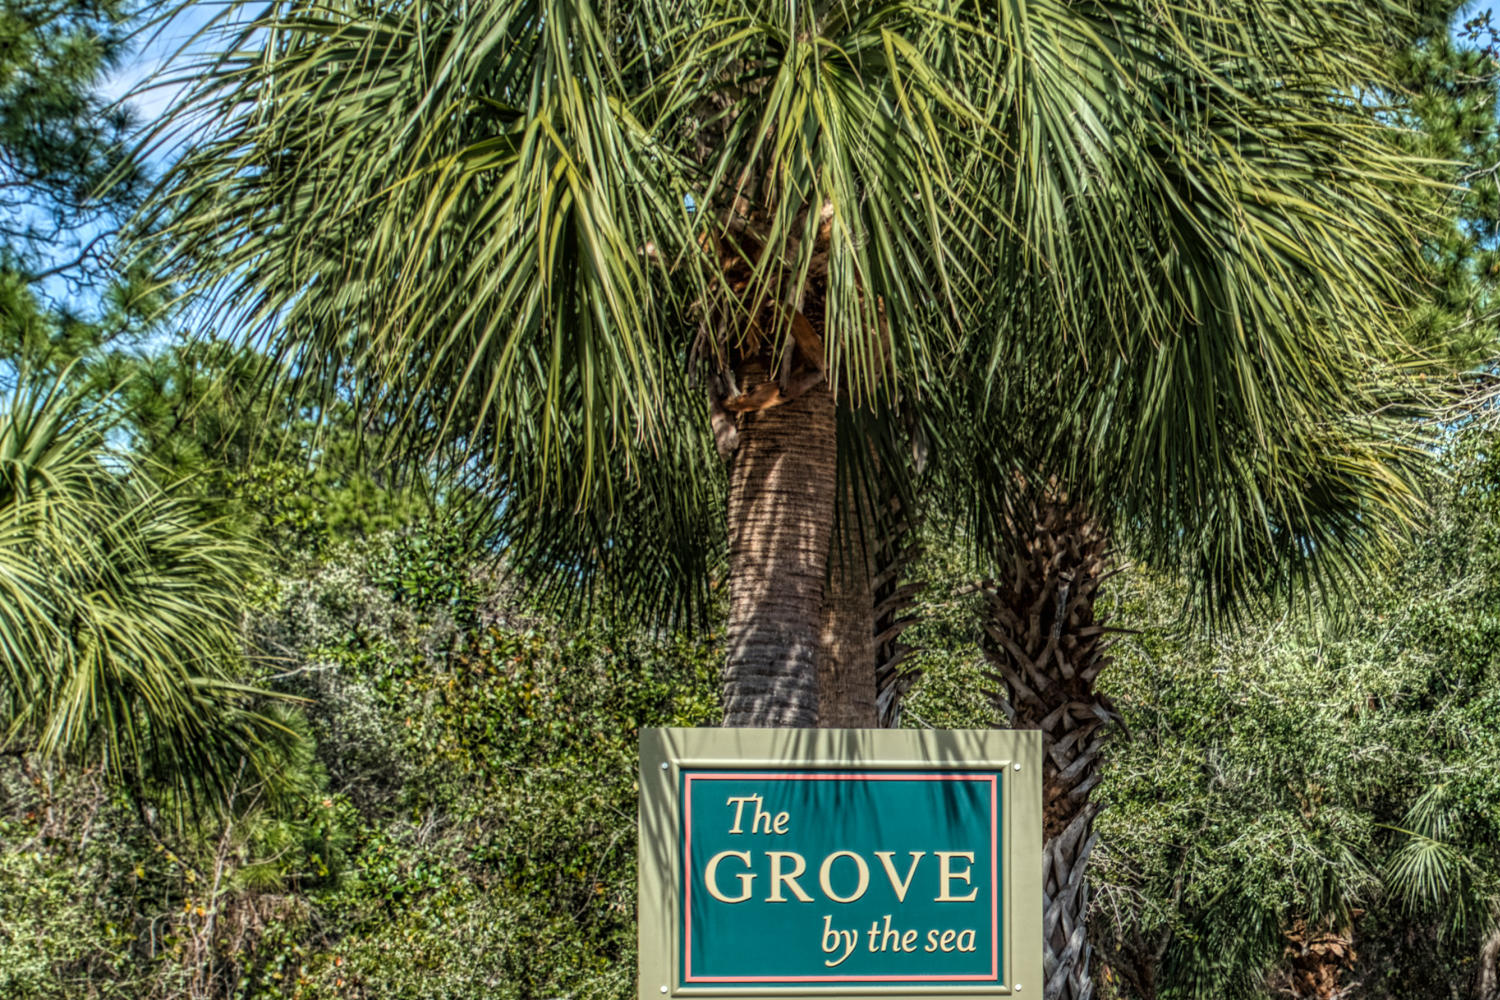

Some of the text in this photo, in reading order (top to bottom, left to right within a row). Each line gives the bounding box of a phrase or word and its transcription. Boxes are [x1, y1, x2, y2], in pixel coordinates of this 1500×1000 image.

[726, 792, 790, 835] The
[704, 849, 979, 904] GROVE
[821, 914, 977, 968] by the sea
